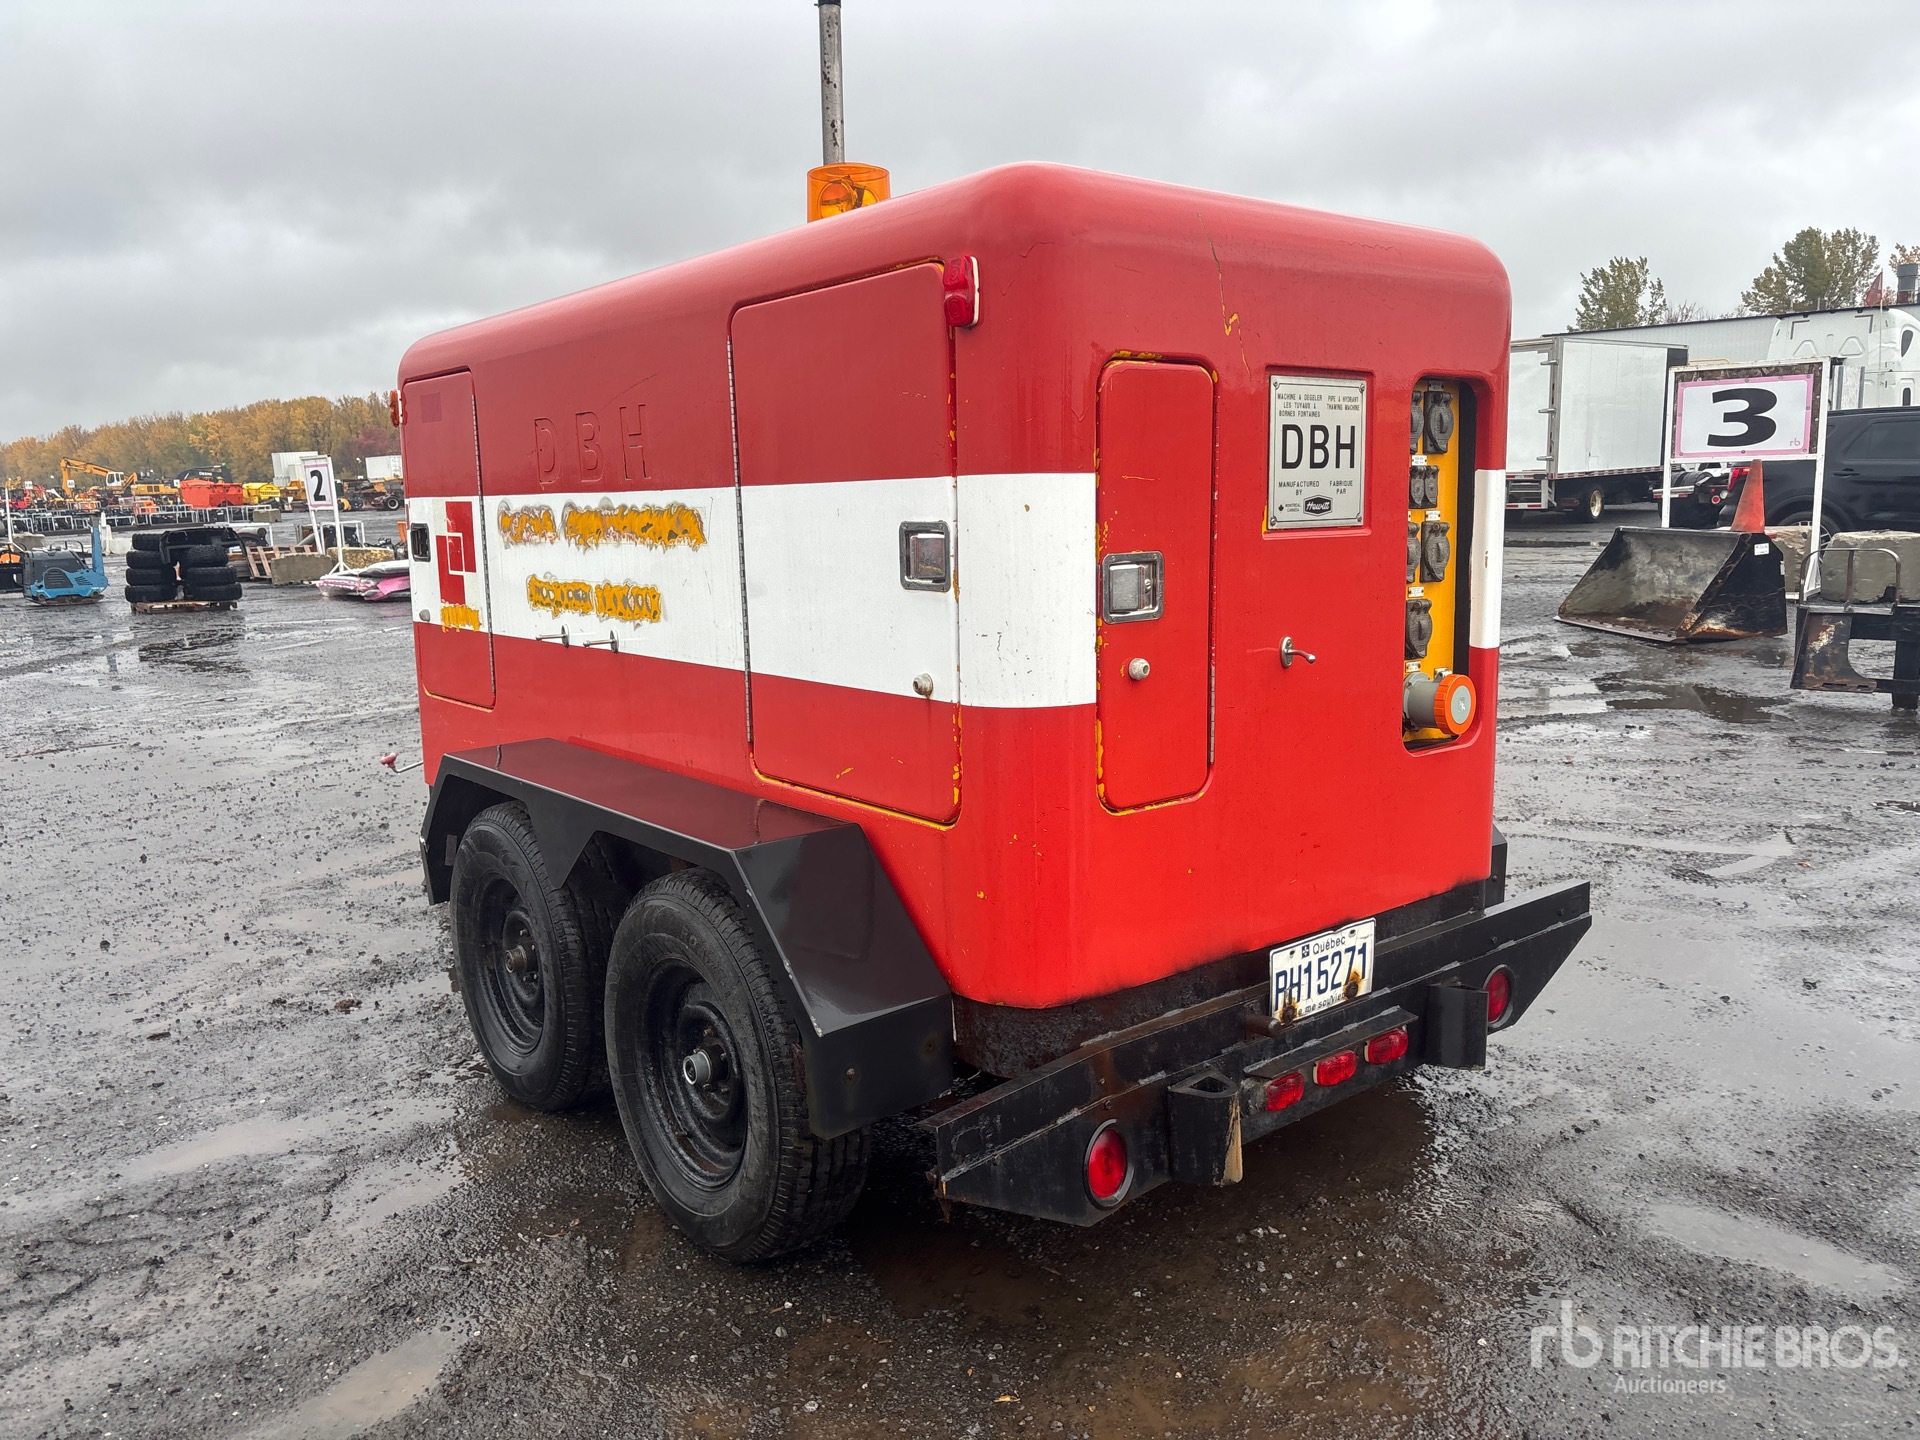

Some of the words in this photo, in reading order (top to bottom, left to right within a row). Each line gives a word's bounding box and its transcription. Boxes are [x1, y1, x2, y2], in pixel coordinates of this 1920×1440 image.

[1277, 393, 1296, 401] MACHINE
[1283, 401, 1292, 409] LES
[1294, 401, 1311, 409] TUYAUX
[1707, 387, 1778, 447] 3
[533, 403, 652, 485] DBH
[1281, 424, 1356, 469] DBH
[309, 469, 327, 501] 2
[1278, 480, 1320, 488] MANUFACTURED
[1312, 936, 1346, 955] Québec
[1274, 942, 1367, 1012] PH15271
